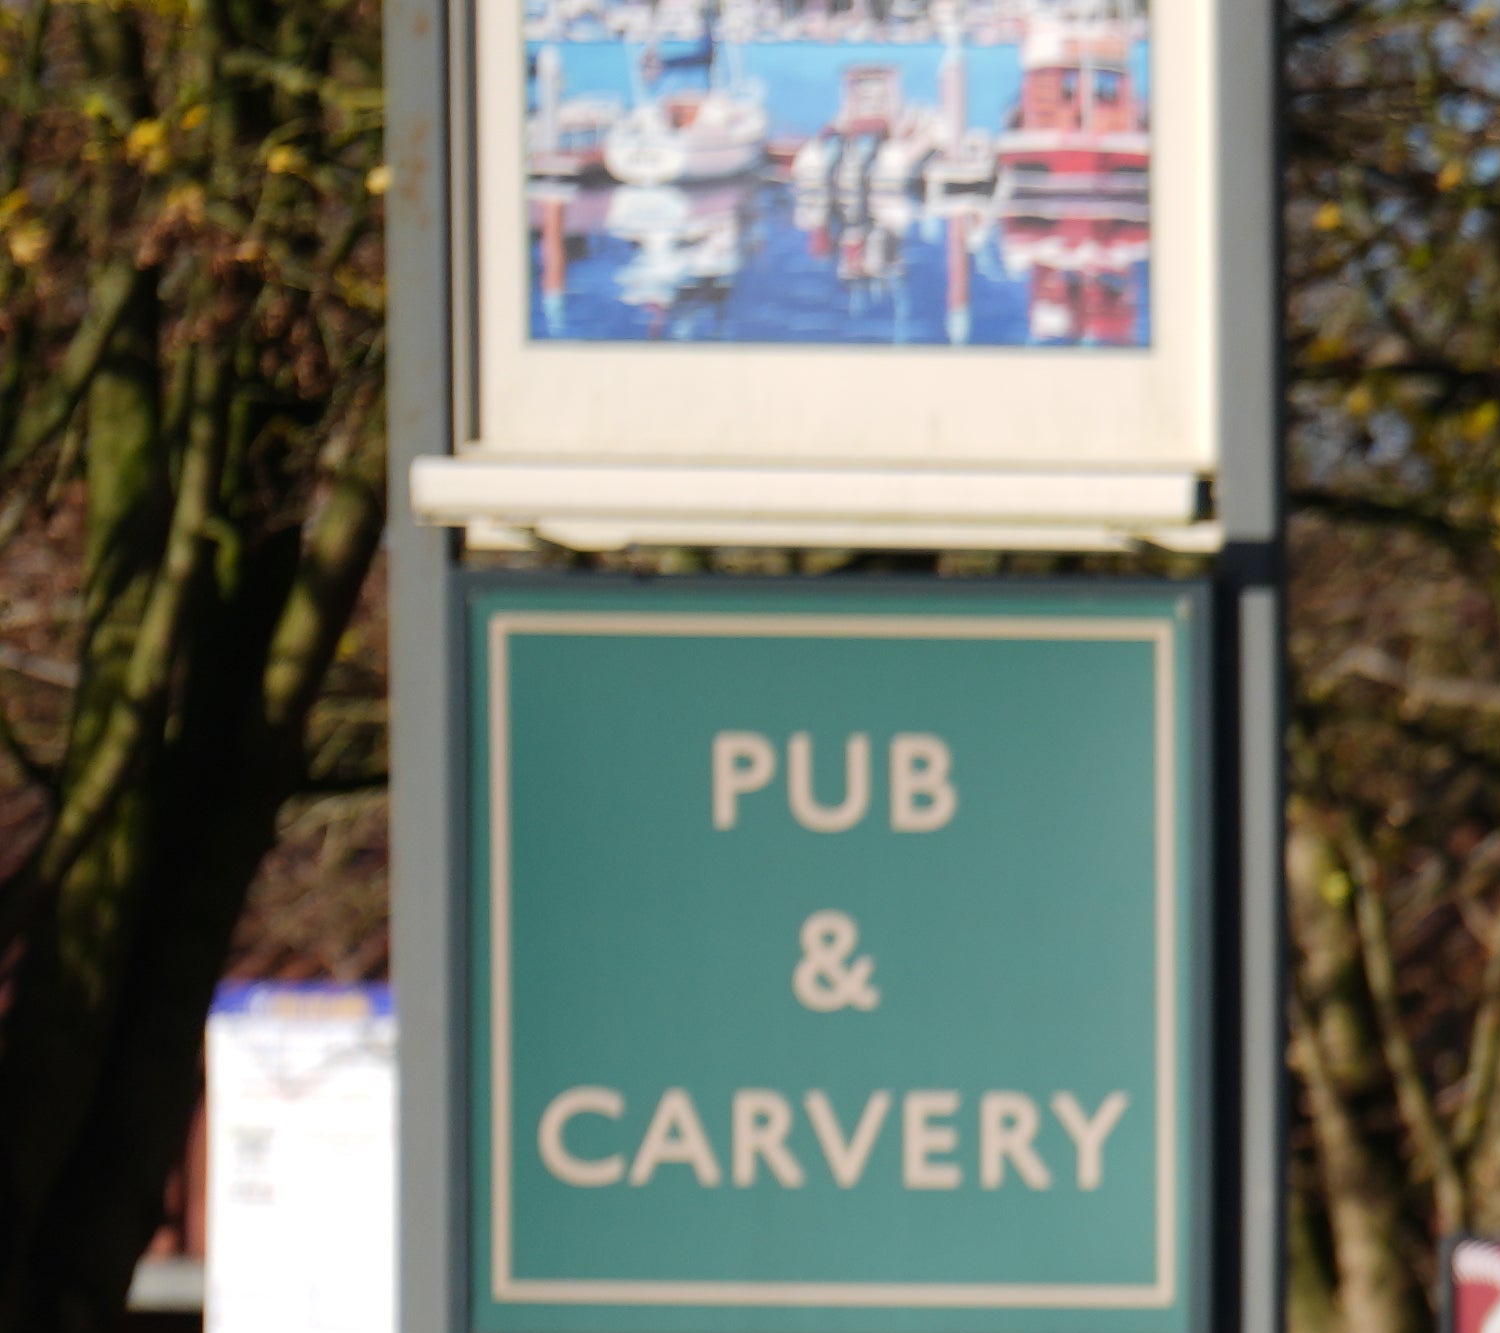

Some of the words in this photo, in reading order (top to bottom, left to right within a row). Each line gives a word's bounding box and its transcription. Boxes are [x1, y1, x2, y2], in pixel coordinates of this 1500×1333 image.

[712, 732, 959, 832] PUB
[792, 908, 881, 1012] &
[537, 1084, 1130, 1192] CARVERY
